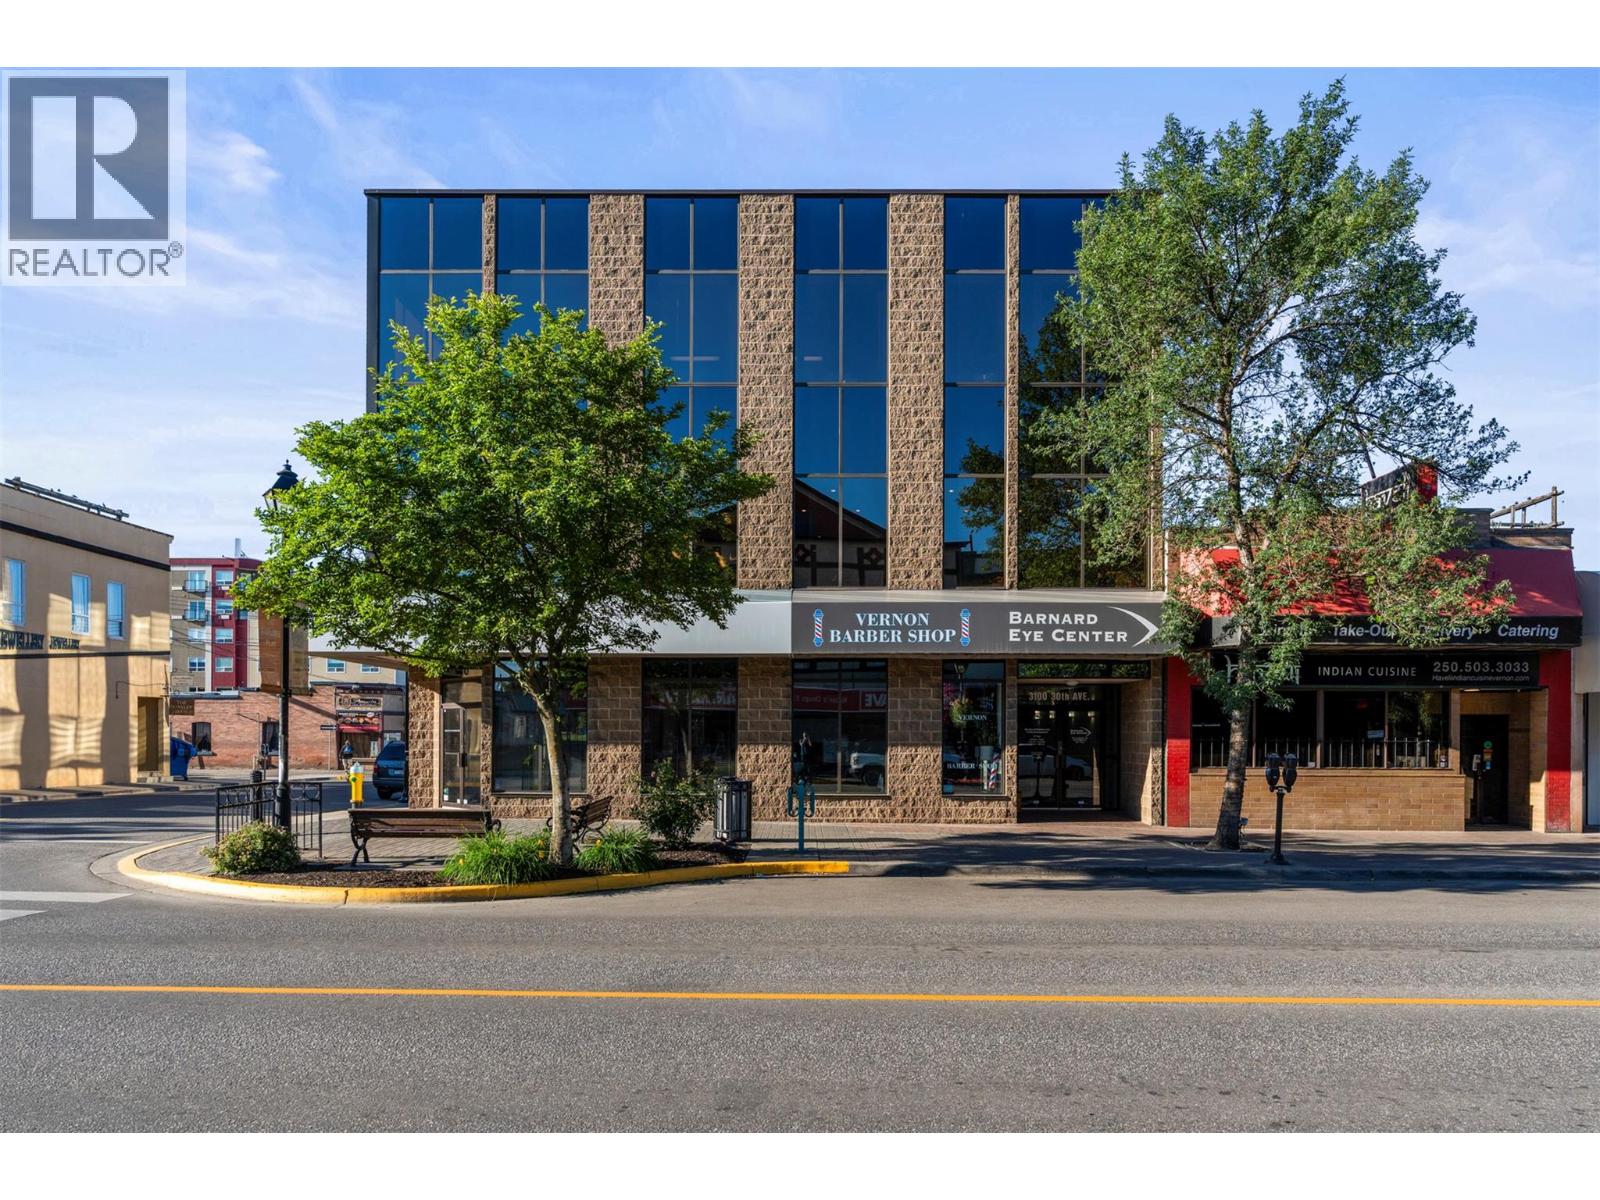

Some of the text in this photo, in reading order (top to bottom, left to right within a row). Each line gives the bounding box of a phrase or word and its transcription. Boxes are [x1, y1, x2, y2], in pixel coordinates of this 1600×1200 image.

[856, 613, 930, 626] VERNON
[1009, 611, 1098, 625] BARNARD
[829, 629, 957, 643] BARBER SHOP
[1009, 629, 1128, 642] EYE CENTER
[1418, 624, 1473, 640] Divery
[1498, 624, 1560, 639] Catering
[1318, 666, 1362, 677] INDIAN
[1367, 666, 1417, 677] CUISINE
[1432, 661, 1530, 673] 250.503.3033
[1029, 691, 1048, 701] 3100
[1051, 691, 1070, 701] 30th
[946, 762, 975, 770] BARBER
